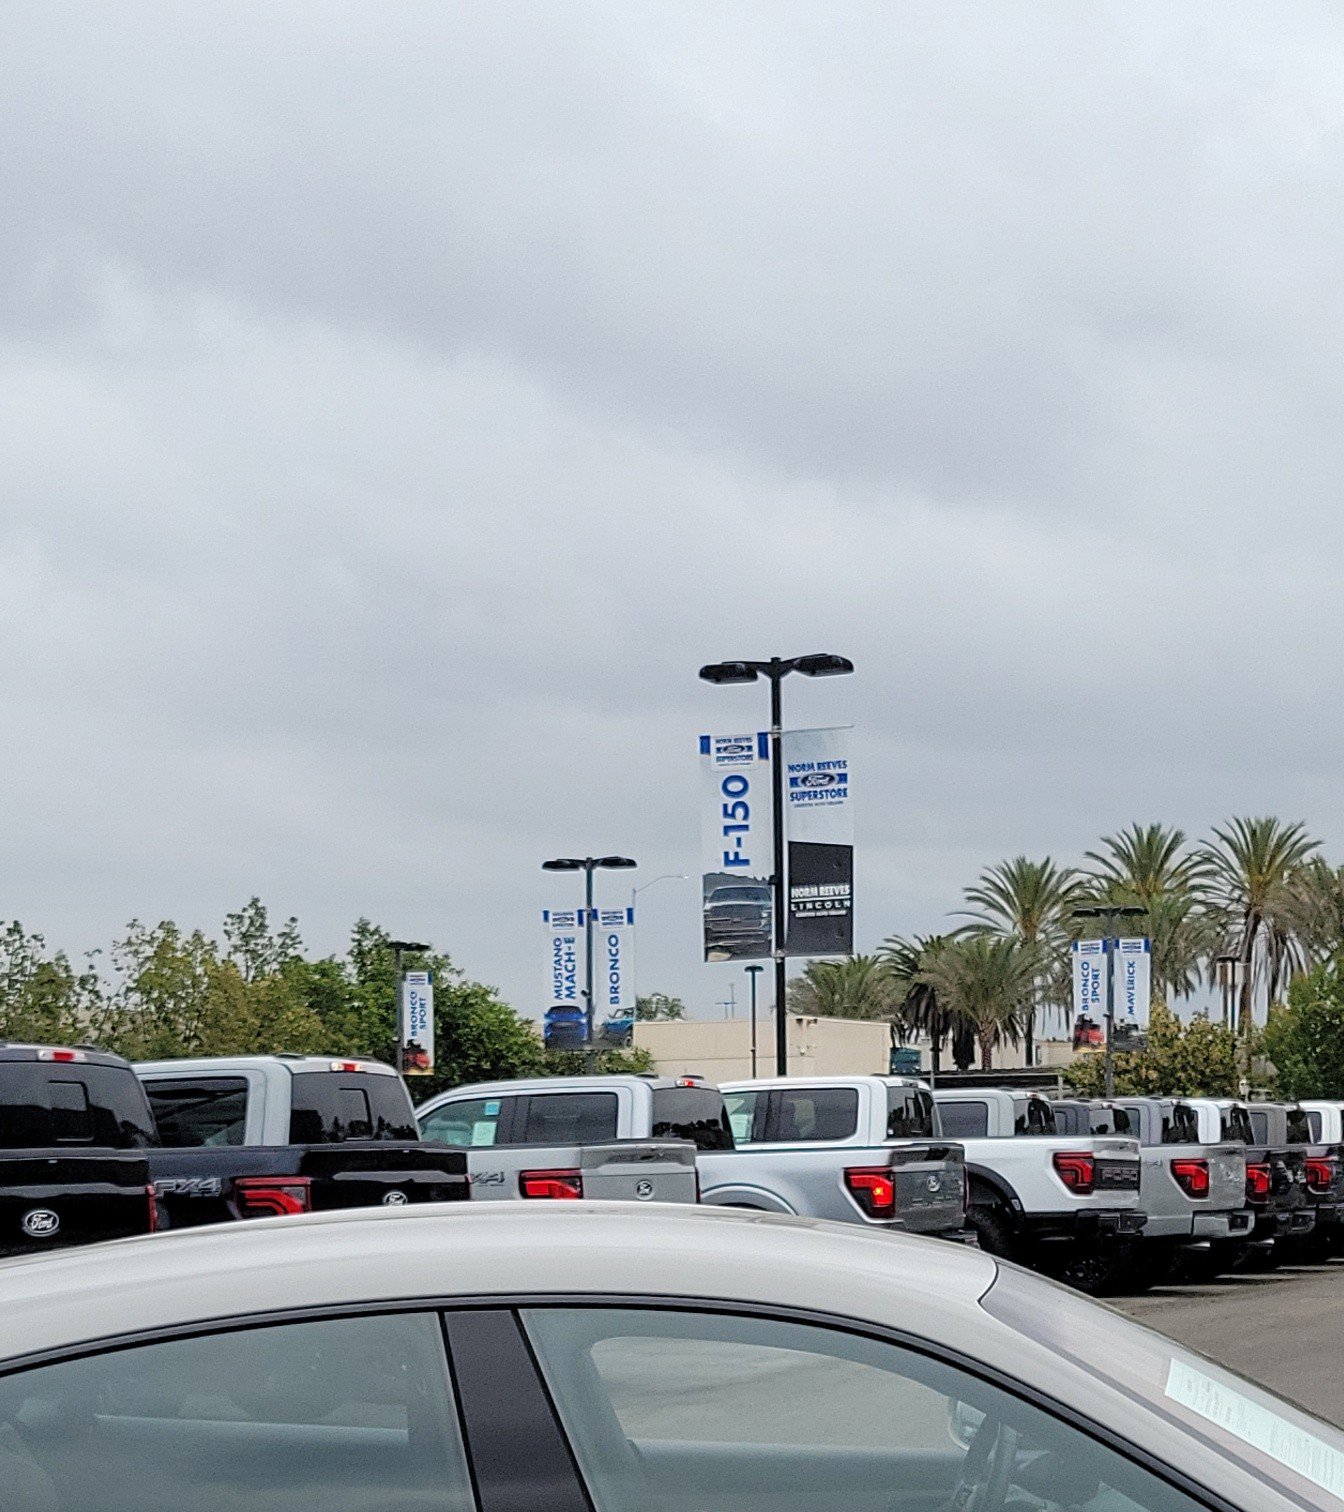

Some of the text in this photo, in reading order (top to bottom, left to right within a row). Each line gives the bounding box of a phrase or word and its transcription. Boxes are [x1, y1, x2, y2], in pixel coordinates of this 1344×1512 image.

[789, 787, 848, 802] SUPERSTORE
[721, 774, 751, 868] F-150
[790, 899, 851, 911] LINCOLN
[564, 936, 576, 1000] MACH-E
[607, 934, 620, 1005] BRONCO
[409, 991, 418, 1037] BRONCO
[471, 1171, 506, 1185] X4
